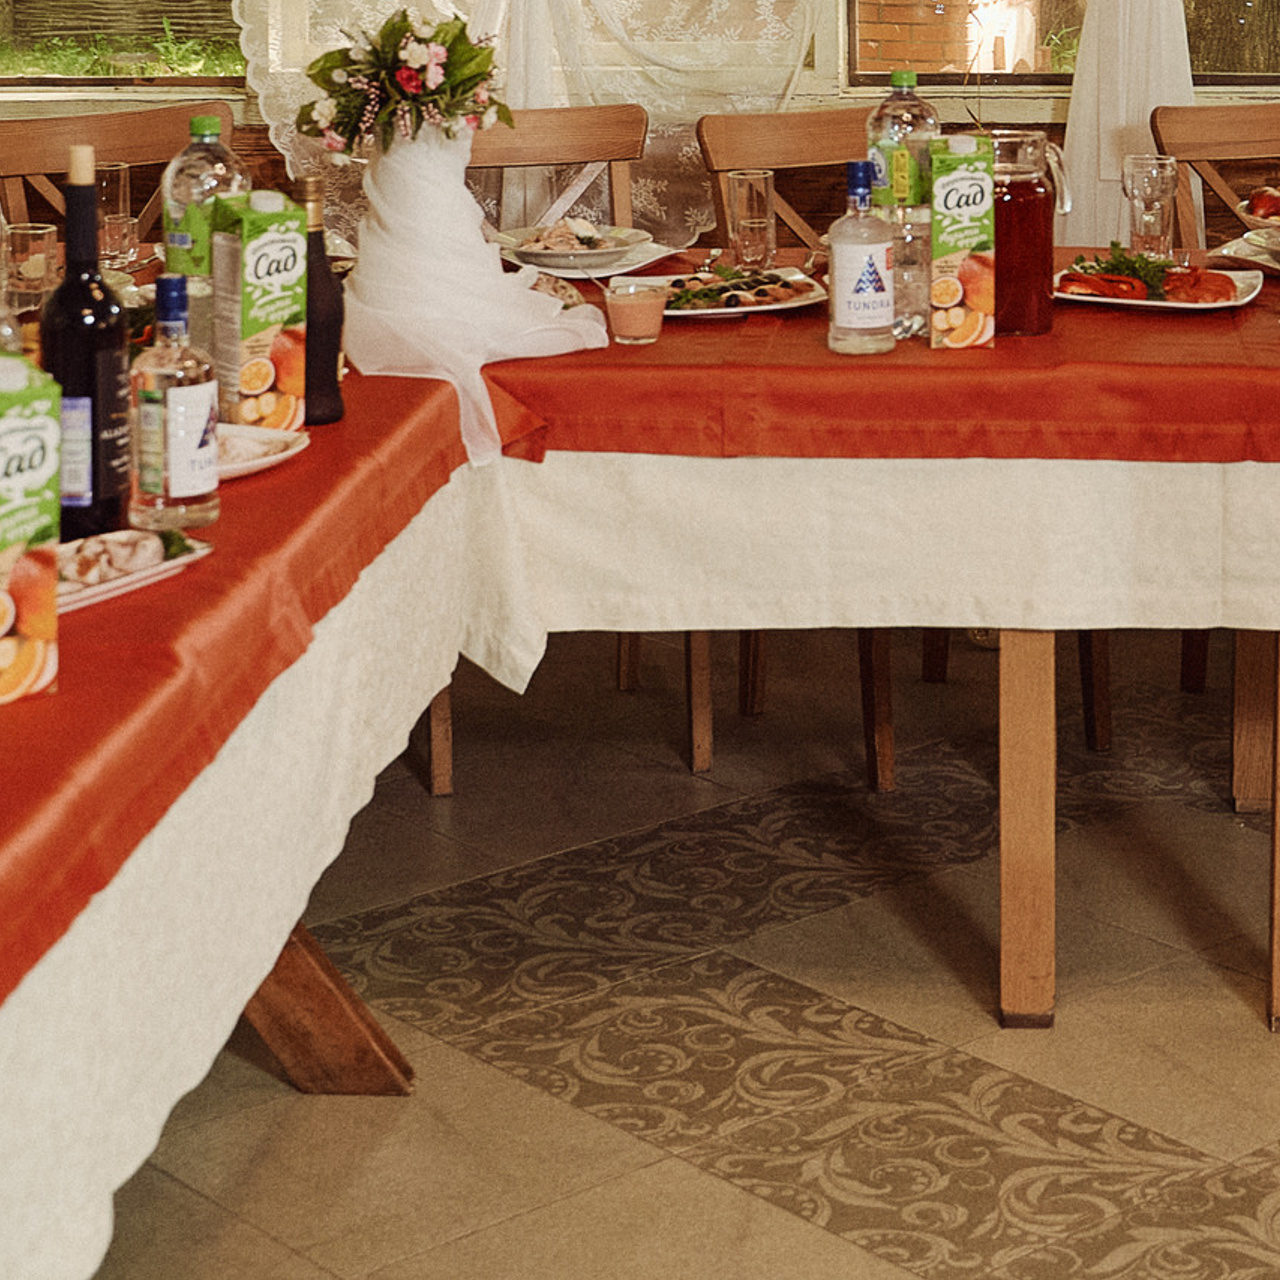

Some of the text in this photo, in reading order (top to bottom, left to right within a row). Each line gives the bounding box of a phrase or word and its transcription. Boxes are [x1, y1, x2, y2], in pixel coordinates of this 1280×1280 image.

[944, 183, 985, 210] Сад
[254, 246, 297, 280] Сад
[847, 300, 891, 311] TUNDRA
[0, 434, 46, 478] ад
